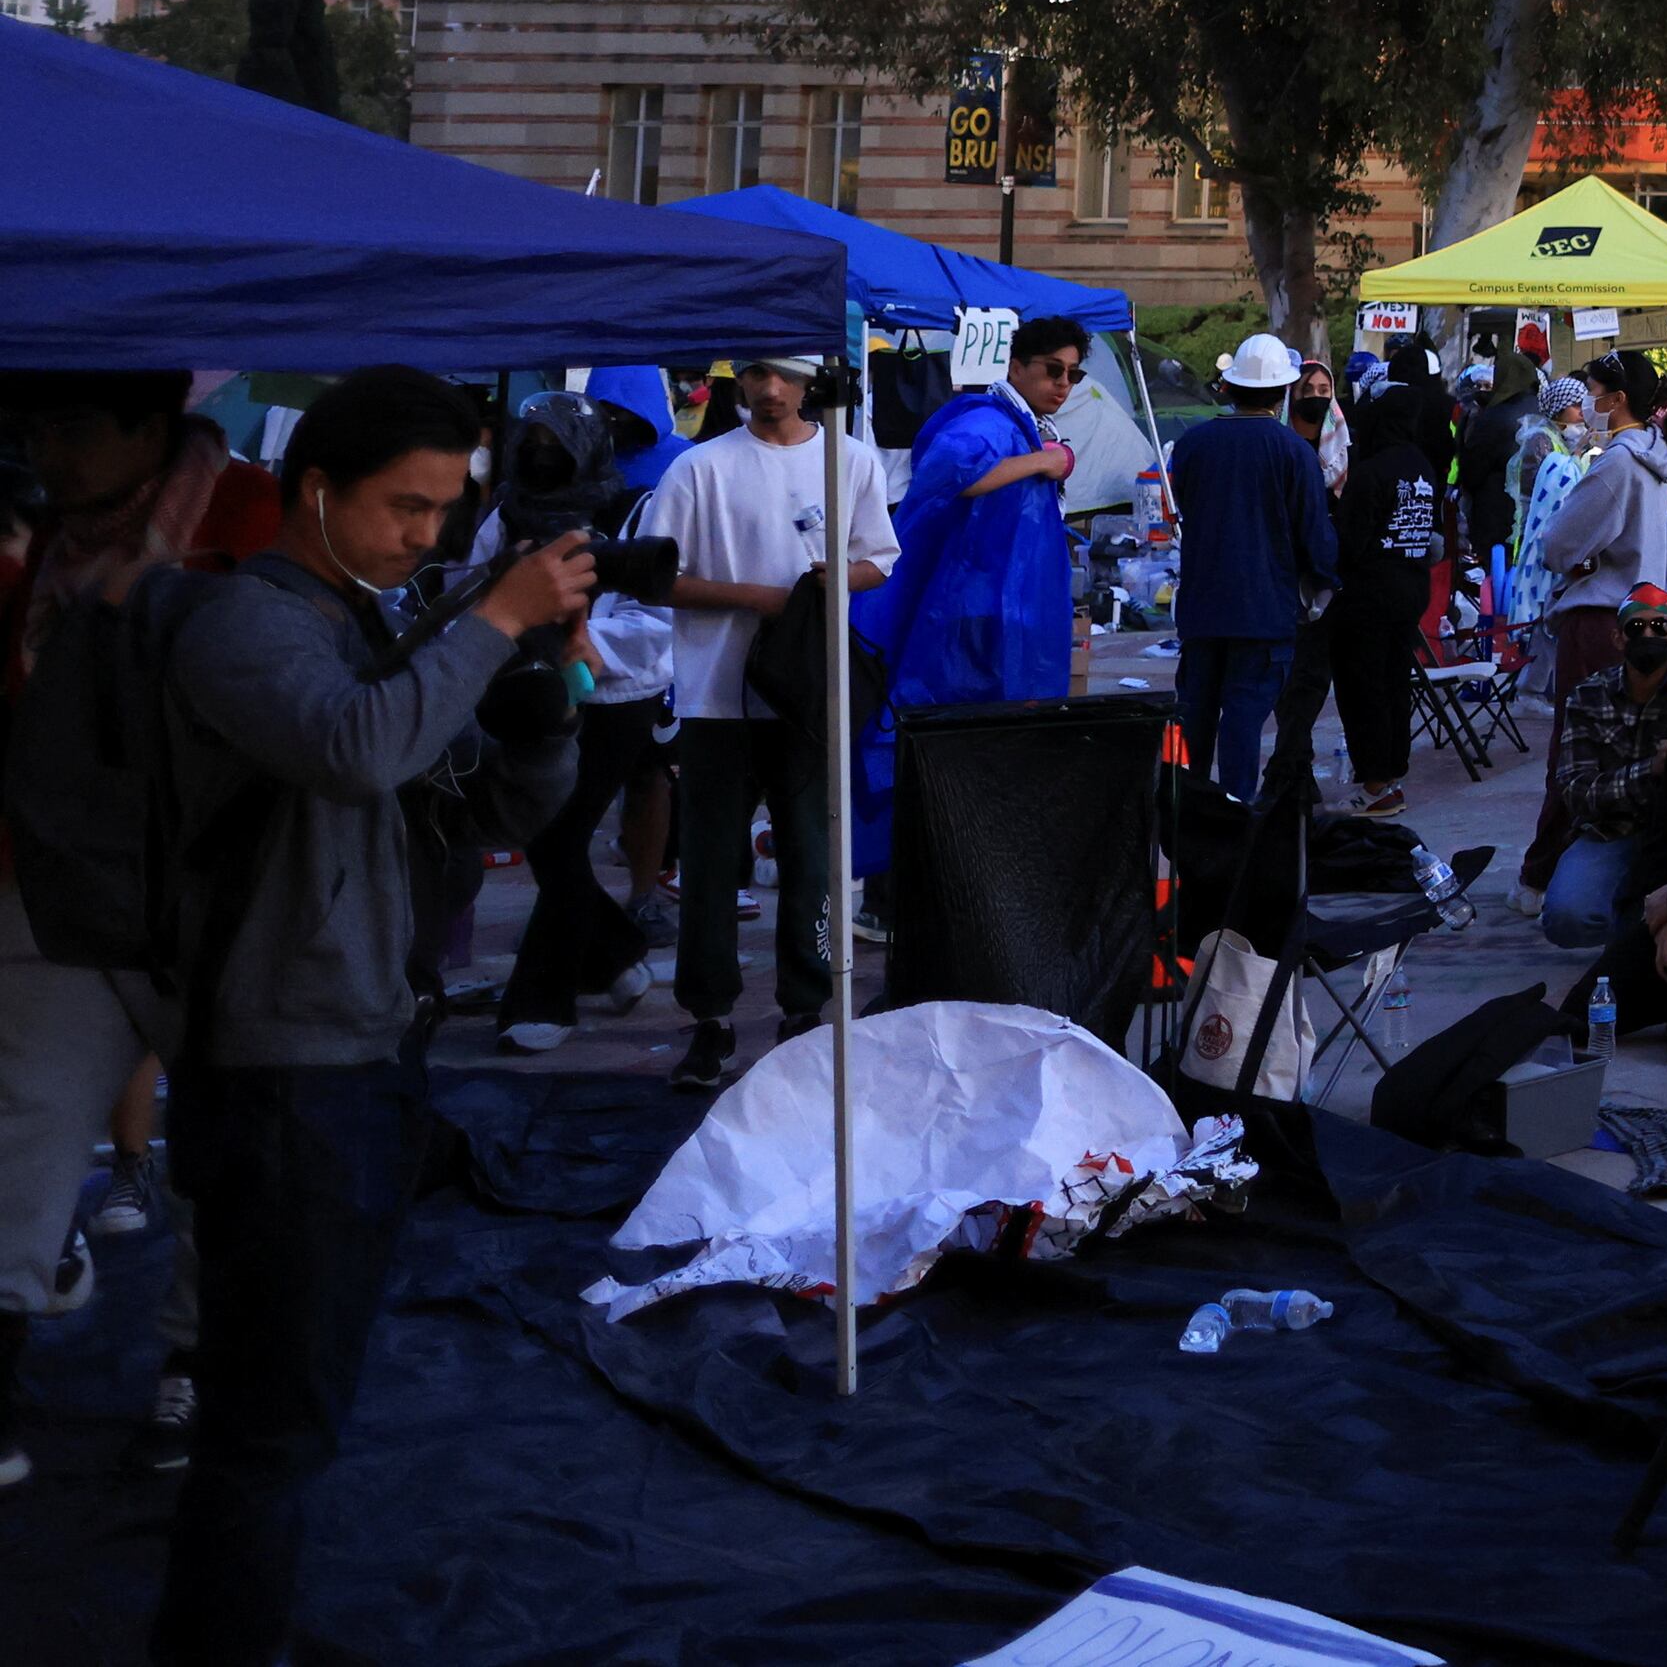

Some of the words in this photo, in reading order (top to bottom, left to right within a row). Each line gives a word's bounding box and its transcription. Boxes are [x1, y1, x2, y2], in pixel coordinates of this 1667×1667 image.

[950, 106, 992, 137] GO
[1533, 233, 1592, 258] CEC
[1469, 283, 1514, 295] Campus
[1518, 283, 1554, 293] Events
[1557, 283, 1626, 293] Commission
[1372, 314, 1407, 329] NOW
[961, 320, 1011, 366] PPE
